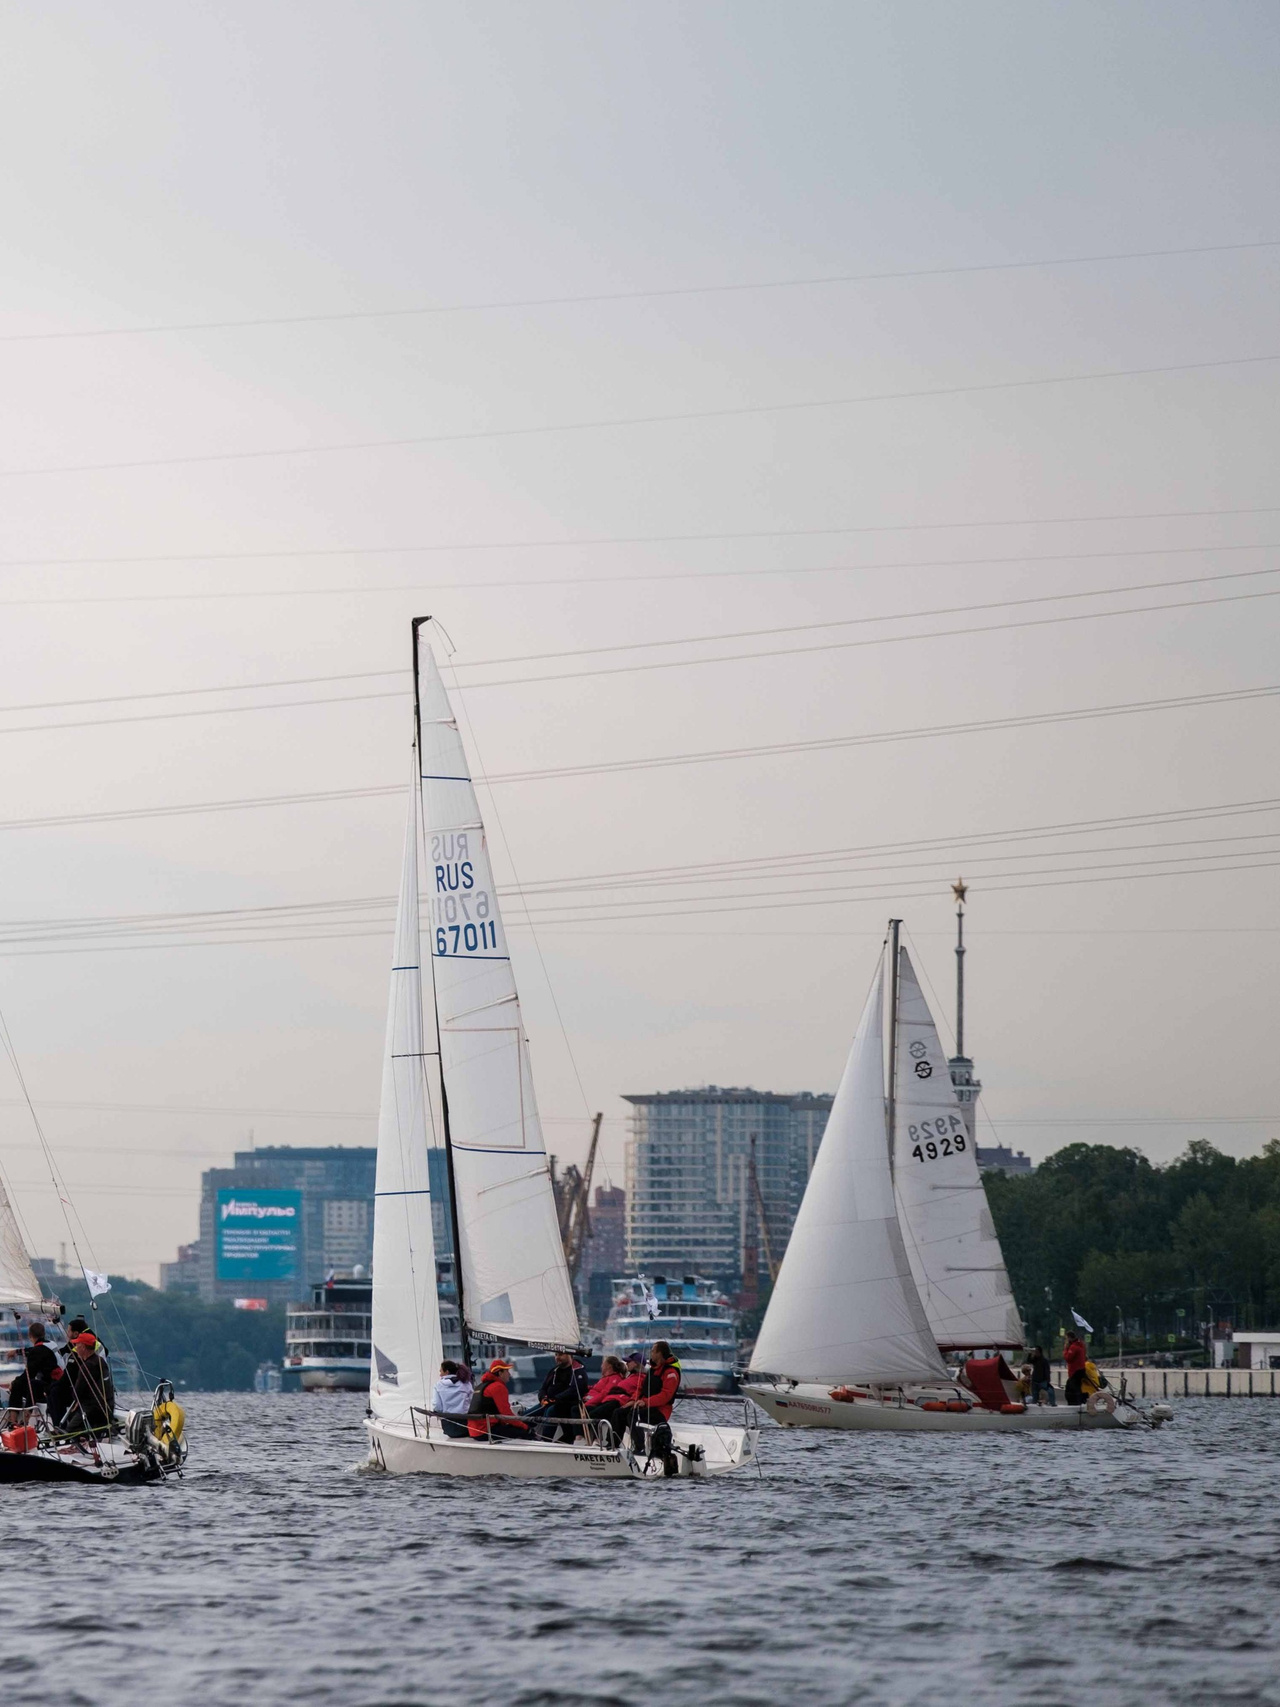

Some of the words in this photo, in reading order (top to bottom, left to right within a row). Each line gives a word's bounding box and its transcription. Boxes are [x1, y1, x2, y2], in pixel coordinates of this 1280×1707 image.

[435, 861, 474, 893] RUS
[436, 920, 497, 956] 67011
[912, 1134, 967, 1163] 4929
[606, 1455, 621, 1464] 670
